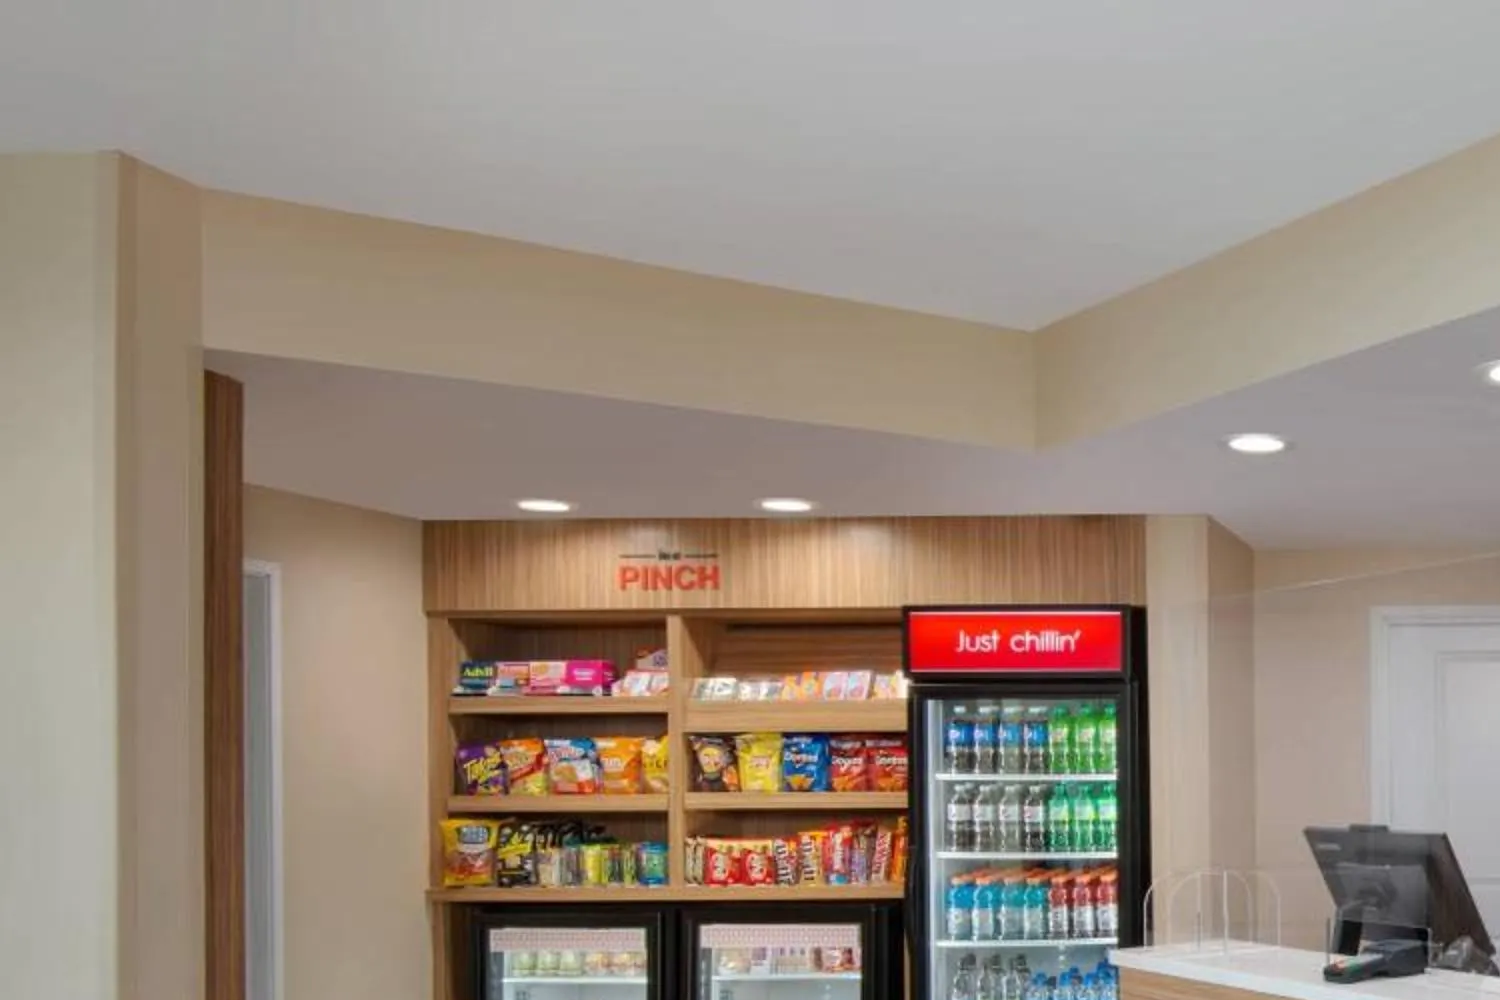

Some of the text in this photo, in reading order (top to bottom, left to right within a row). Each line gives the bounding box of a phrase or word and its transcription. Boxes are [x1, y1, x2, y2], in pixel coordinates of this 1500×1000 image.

[619, 564, 720, 592] PINCH
[956, 629, 1082, 653] Just chillin'
